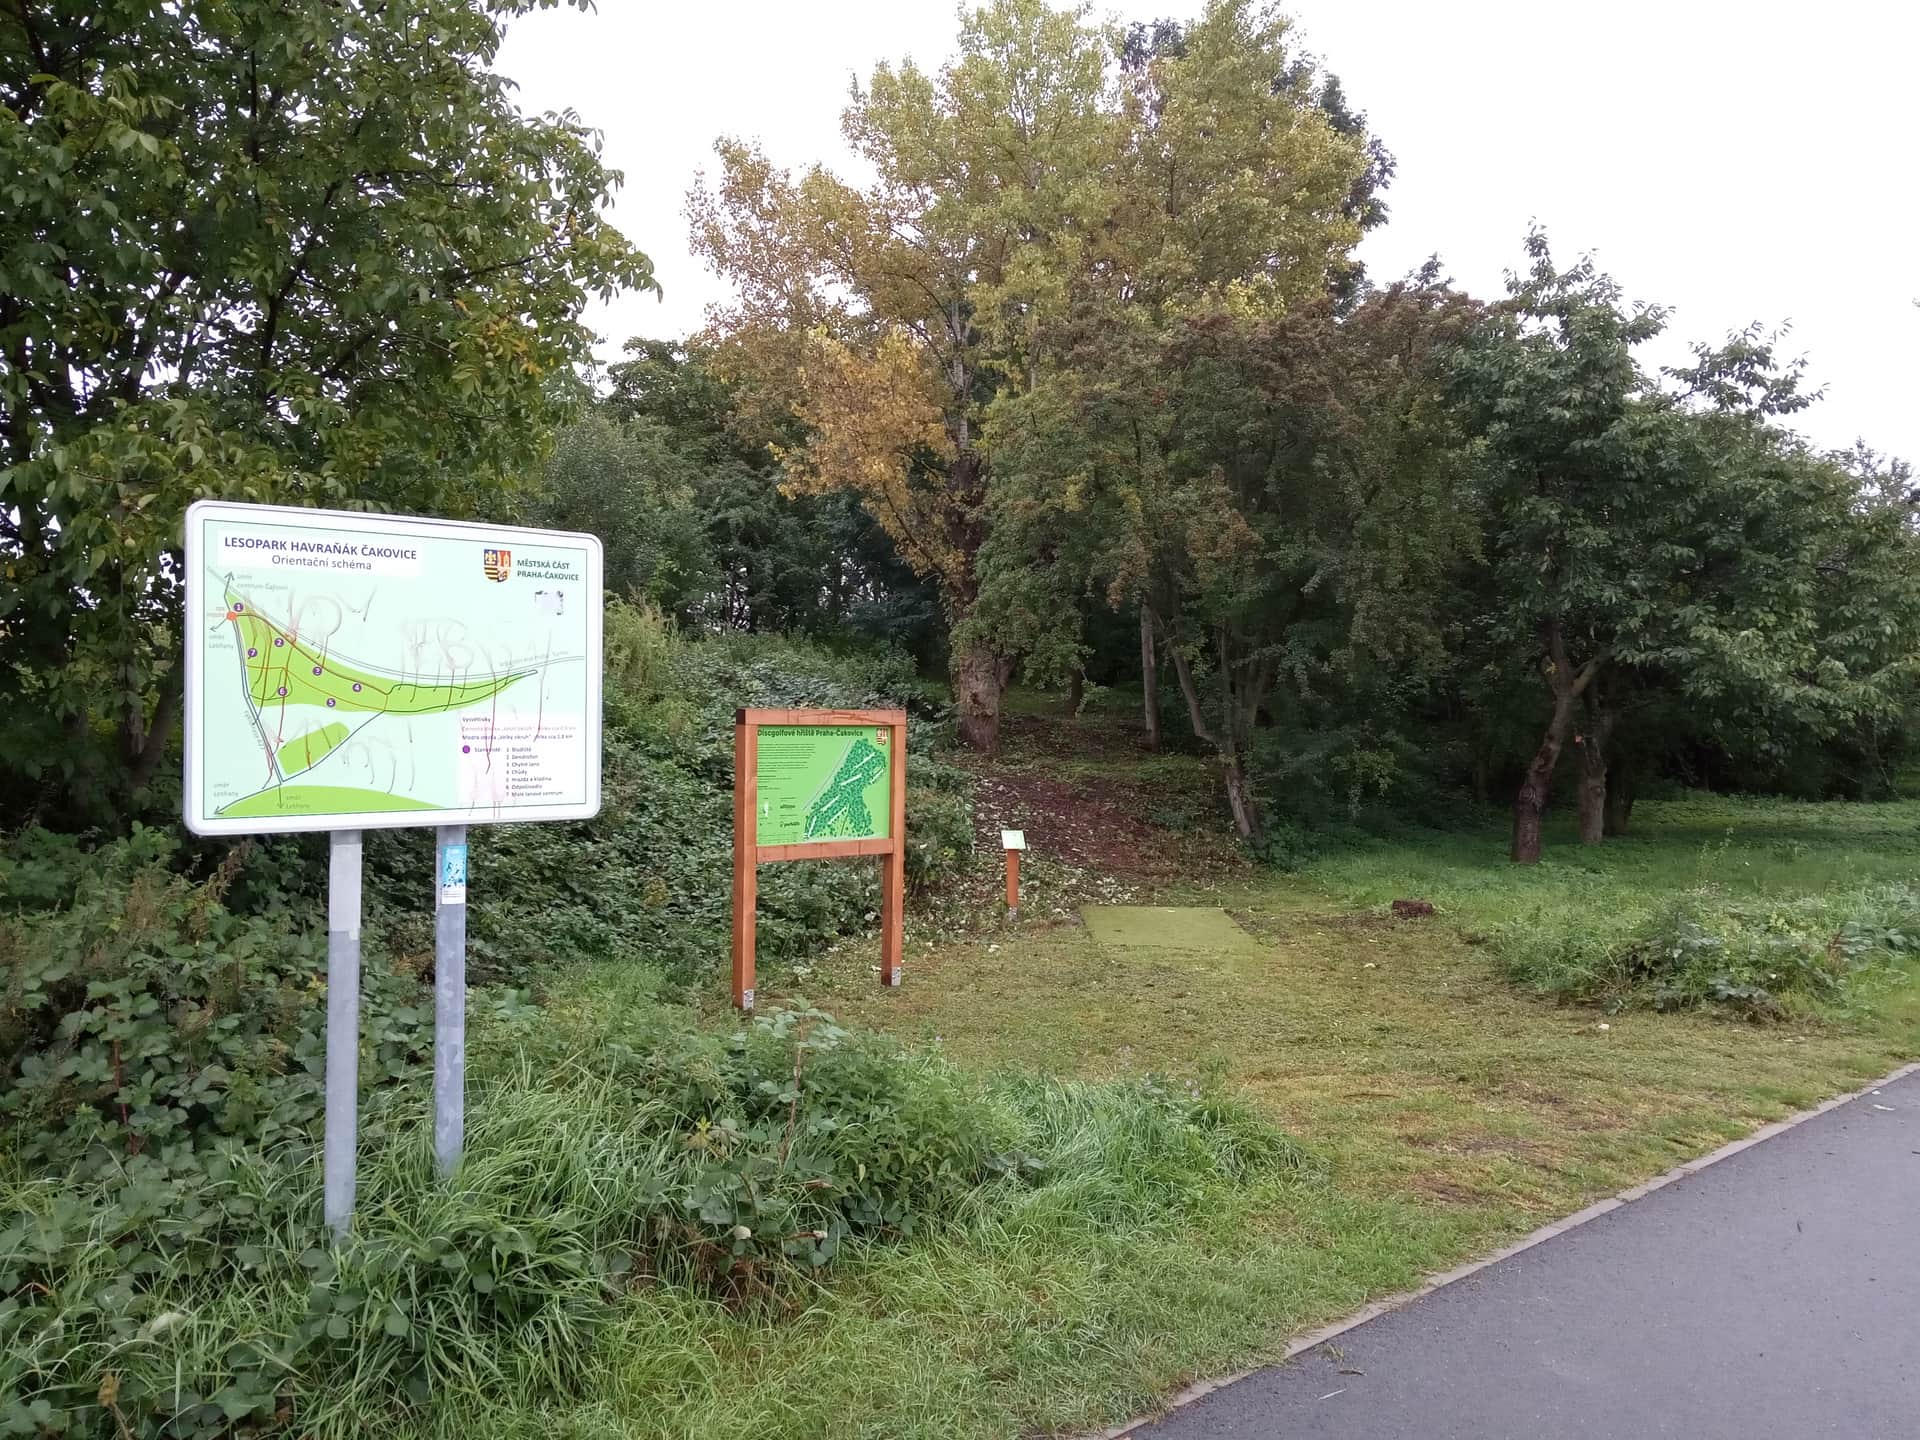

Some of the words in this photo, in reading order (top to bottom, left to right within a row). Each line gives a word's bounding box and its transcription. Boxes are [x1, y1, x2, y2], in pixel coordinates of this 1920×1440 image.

[224, 536, 286, 551] LESOPARK
[290, 540, 358, 556] HAVRAŇÁK
[361, 544, 417, 560] ČAKOVICE
[272, 554, 329, 568] Orientační
[332, 558, 372, 570] schéma
[516, 558, 550, 570] MĚSTSKÁ
[552, 559, 570, 570] ČÁST
[516, 570, 580, 582] PRAHA-ČAKOVICE
[756, 728, 795, 738] Discgolfové
[816, 728, 864, 737] Praha-Čakovice
